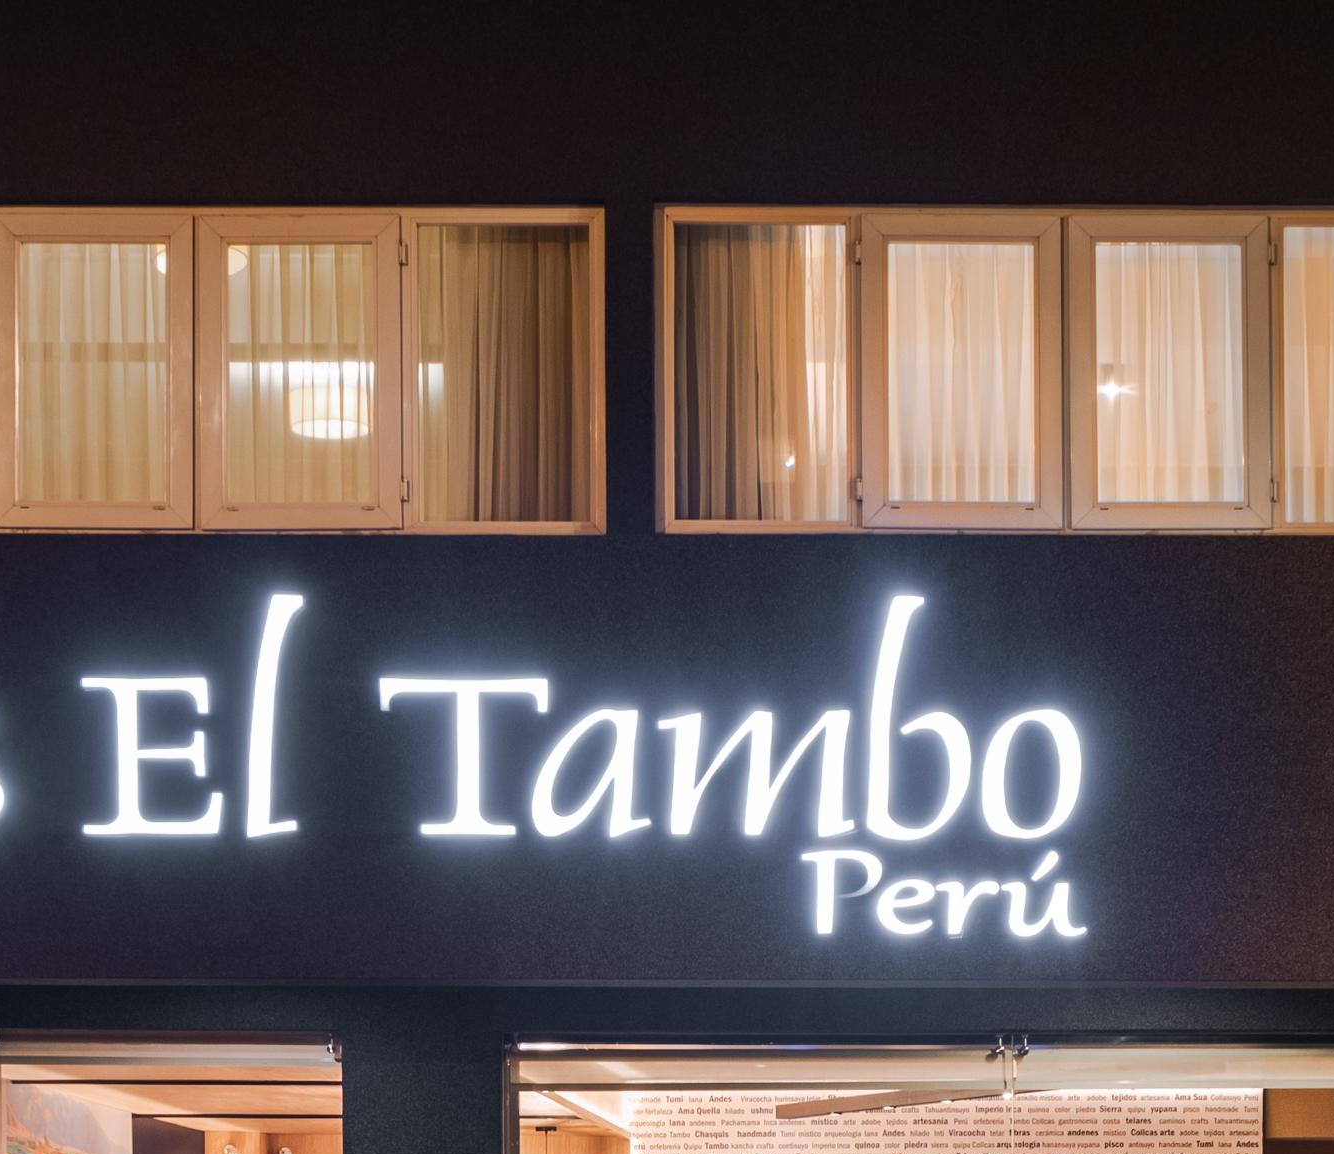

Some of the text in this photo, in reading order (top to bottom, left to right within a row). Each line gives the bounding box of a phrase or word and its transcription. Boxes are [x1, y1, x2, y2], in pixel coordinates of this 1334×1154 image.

[81, 595, 304, 837] El
[379, 595, 1083, 840] Tambo
[801, 850, 1087, 938] Perú
[666, 1095, 683, 1103] Tumi
[1112, 1093, 1137, 1103] tejidos
[697, 1106, 720, 1116] Quella
[751, 1106, 773, 1114] ushnu
[976, 1105, 1004, 1115] Imperio
[882, 1129, 906, 1137] Andes
[1160, 1128, 1175, 1136] arte
[904, 1141, 928, 1150] piedra
[1104, 1140, 1124, 1150] pisco
